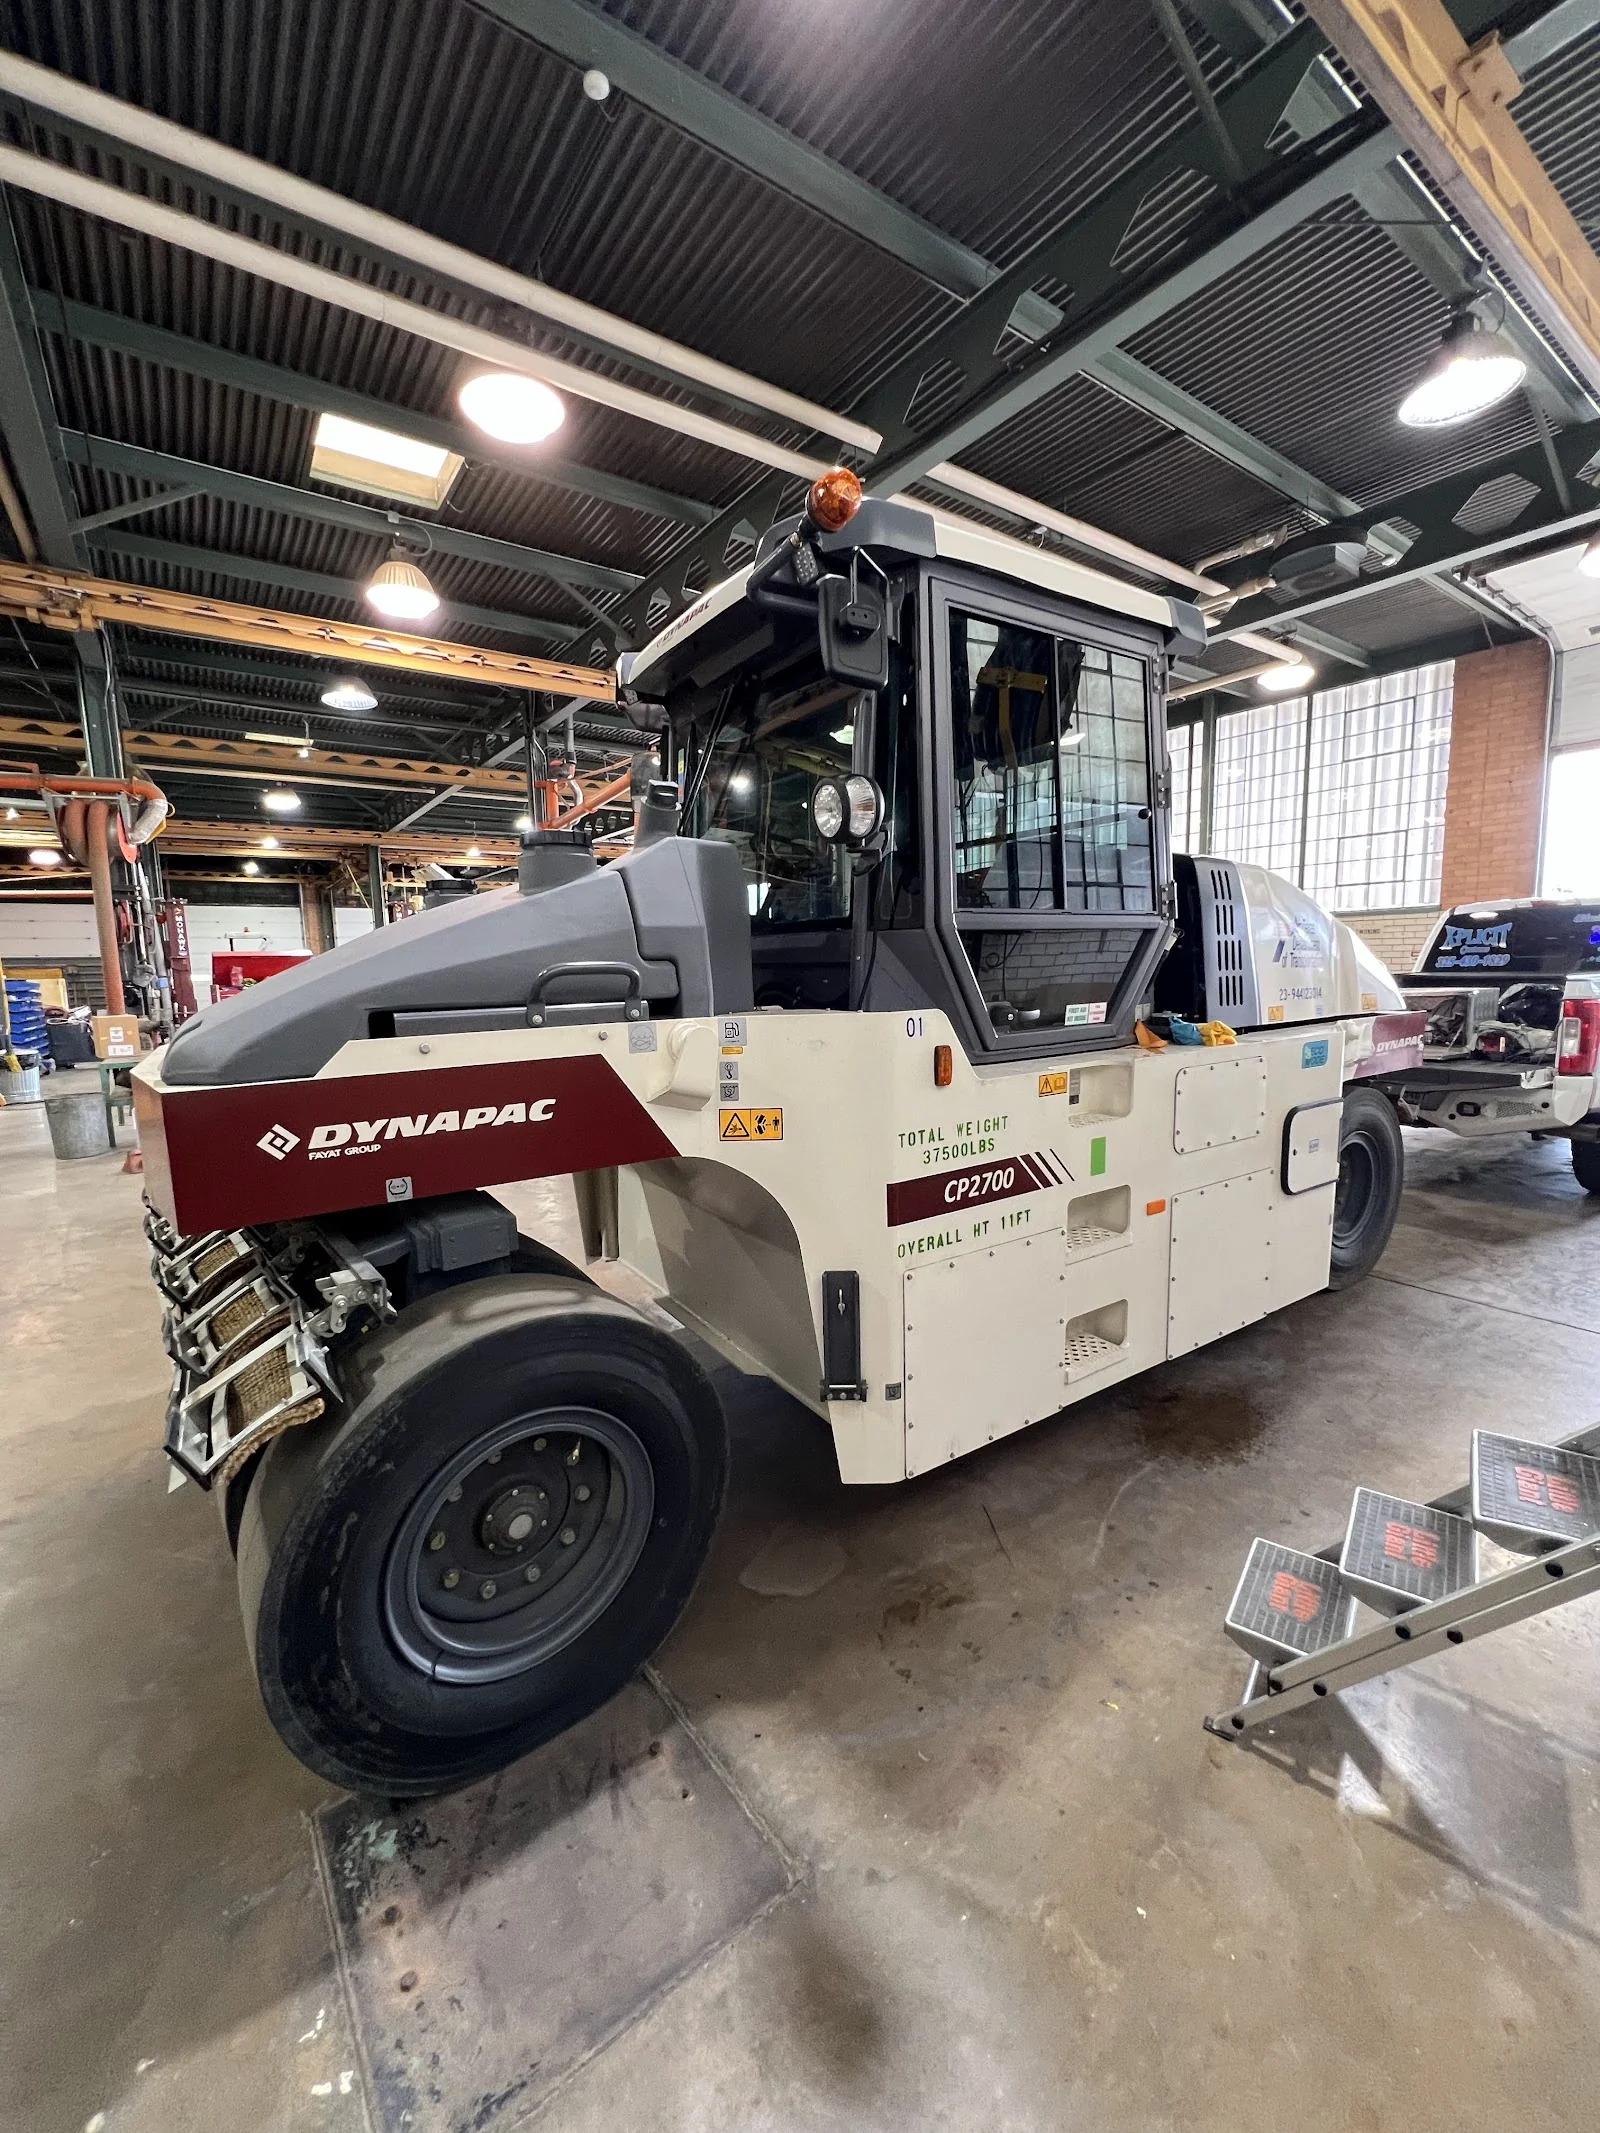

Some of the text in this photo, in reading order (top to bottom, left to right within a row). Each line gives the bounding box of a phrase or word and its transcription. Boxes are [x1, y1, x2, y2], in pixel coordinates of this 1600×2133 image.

[174, 915, 187, 951] MOHAWK
[906, 1017, 922, 1037] 01
[1376, 1034, 1423, 1053] DYNAPAC
[1311, 1046, 1324, 1056] ECO
[308, 1098, 556, 1150] DYNAPAC
[898, 1116, 1008, 1148] TOTAL WEIGHT
[308, 1143, 382, 1161] FAYAT GROUP
[923, 1138, 995, 1164] 37500LBS
[944, 1166, 1015, 1203] CP2700
[897, 1209, 1031, 1258] OVERALL HT 11FT
[1515, 1465, 1547, 1506] Giant
[1385, 1522, 1412, 1561] Giant
